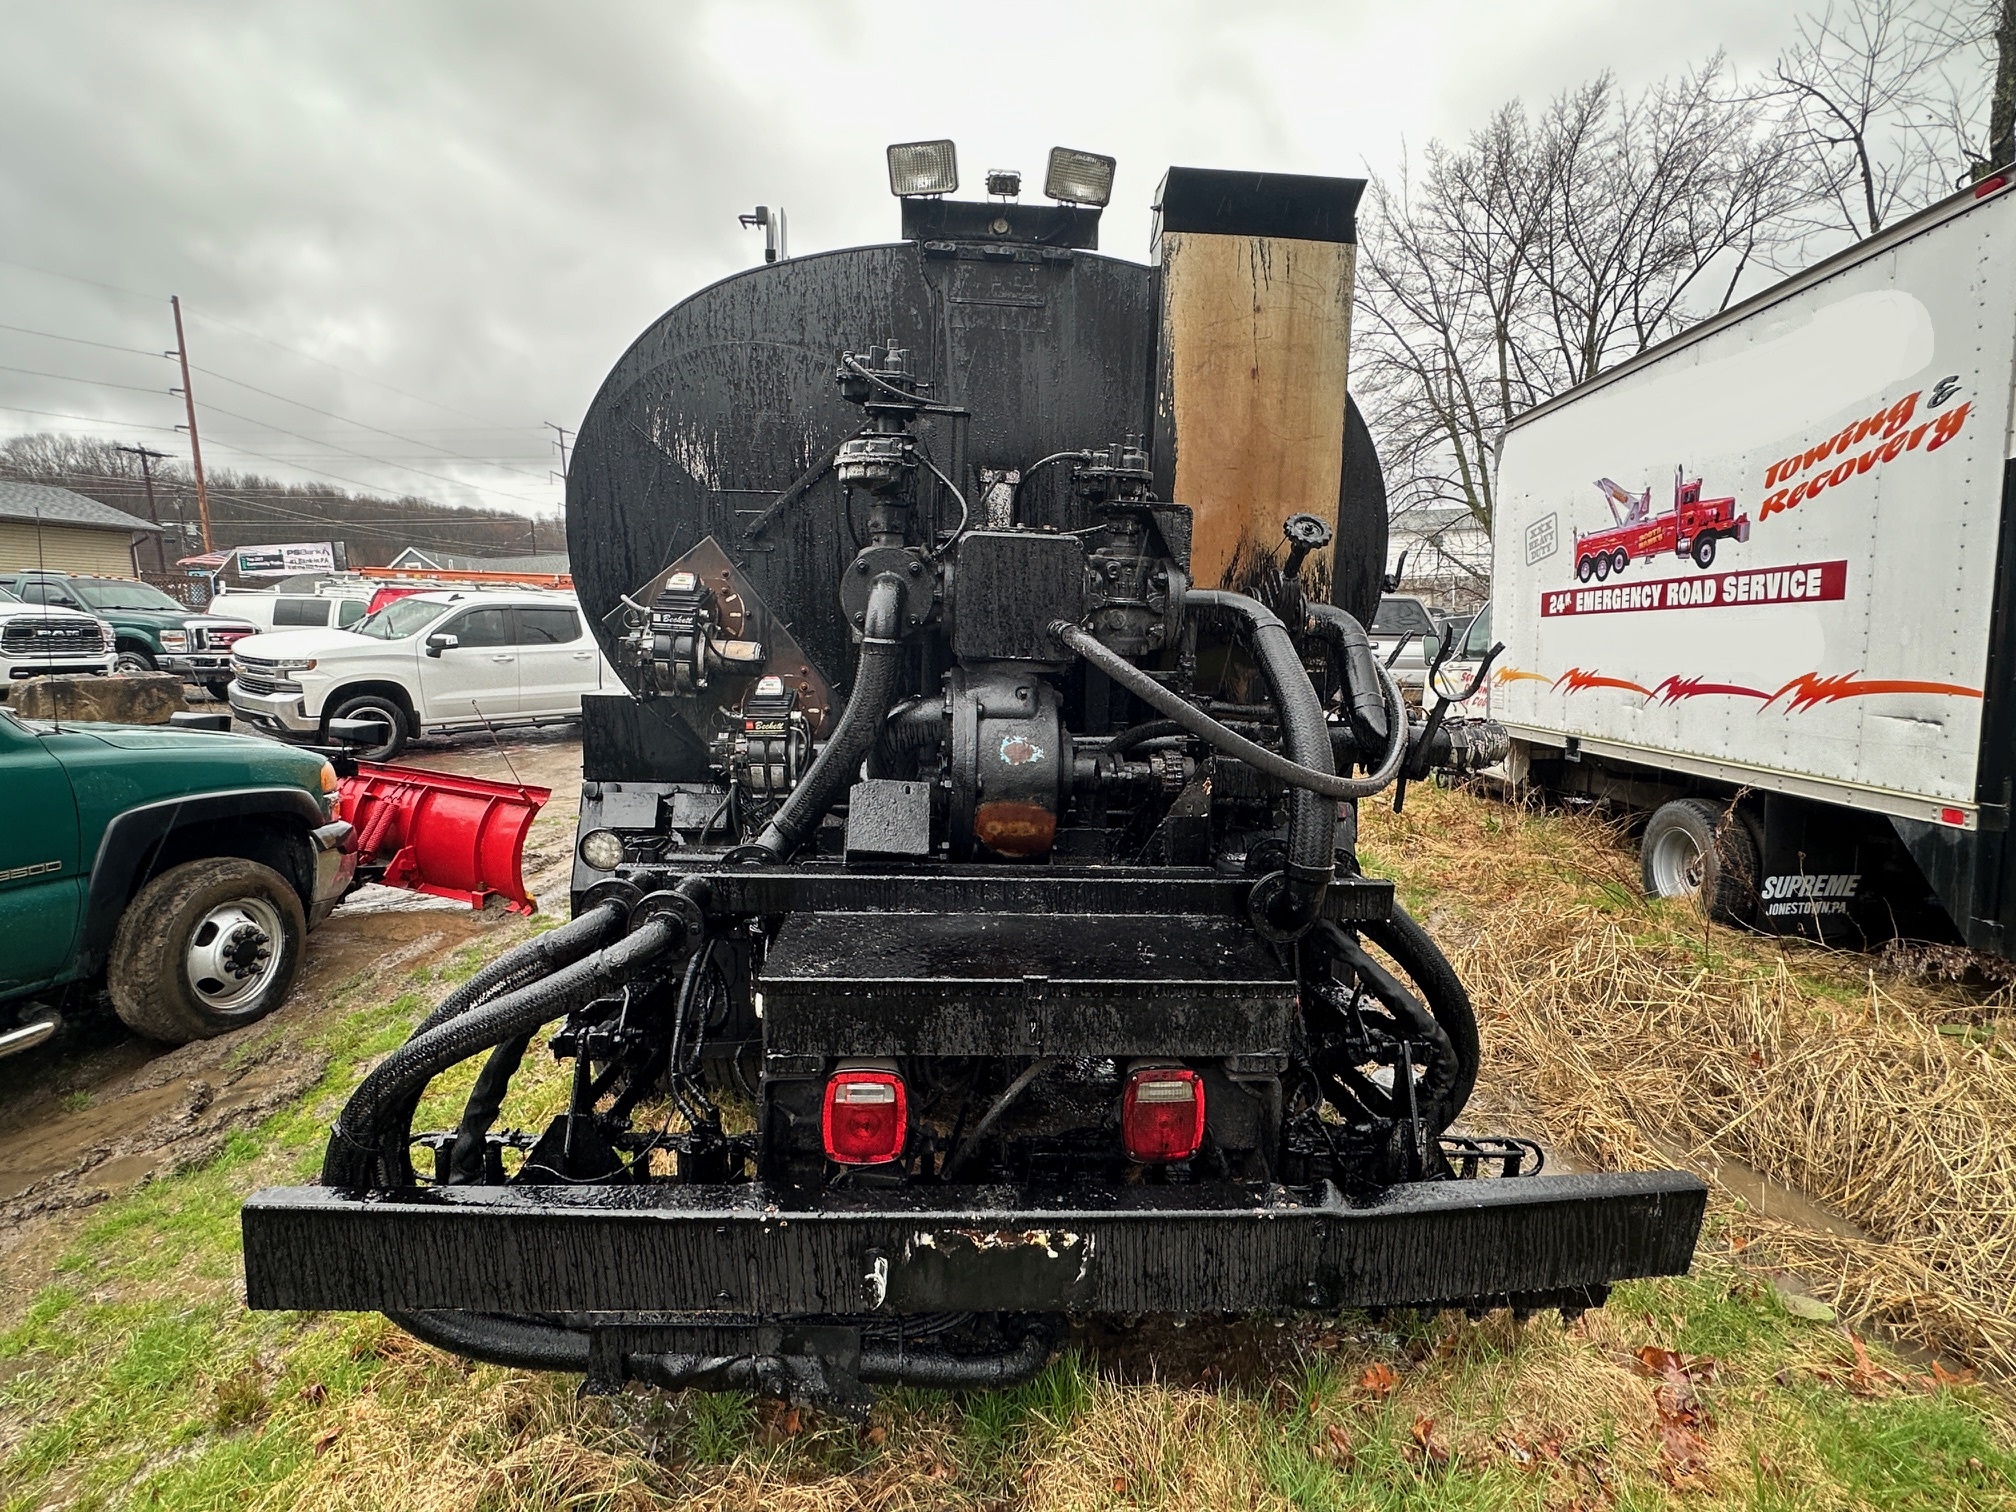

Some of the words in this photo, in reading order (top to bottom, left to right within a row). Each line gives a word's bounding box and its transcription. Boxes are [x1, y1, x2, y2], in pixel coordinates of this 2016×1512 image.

[1764, 390, 1923, 489] Towing
[1926, 375, 1962, 409] &
[1759, 400, 1977, 522] Recovery
[1530, 520, 1552, 539] XXX
[1529, 530, 1554, 551] HEAVY
[1531, 542, 1552, 560] DUTY
[1575, 584, 1663, 613] EMERGENCY
[1666, 578, 1716, 607] ROAD
[1722, 568, 1822, 602] SERVICE
[662, 613, 694, 624] Beckett
[37, 629, 80, 637] RAM
[754, 720, 784, 731] Beckett
[1761, 874, 1862, 899] SUPREME
